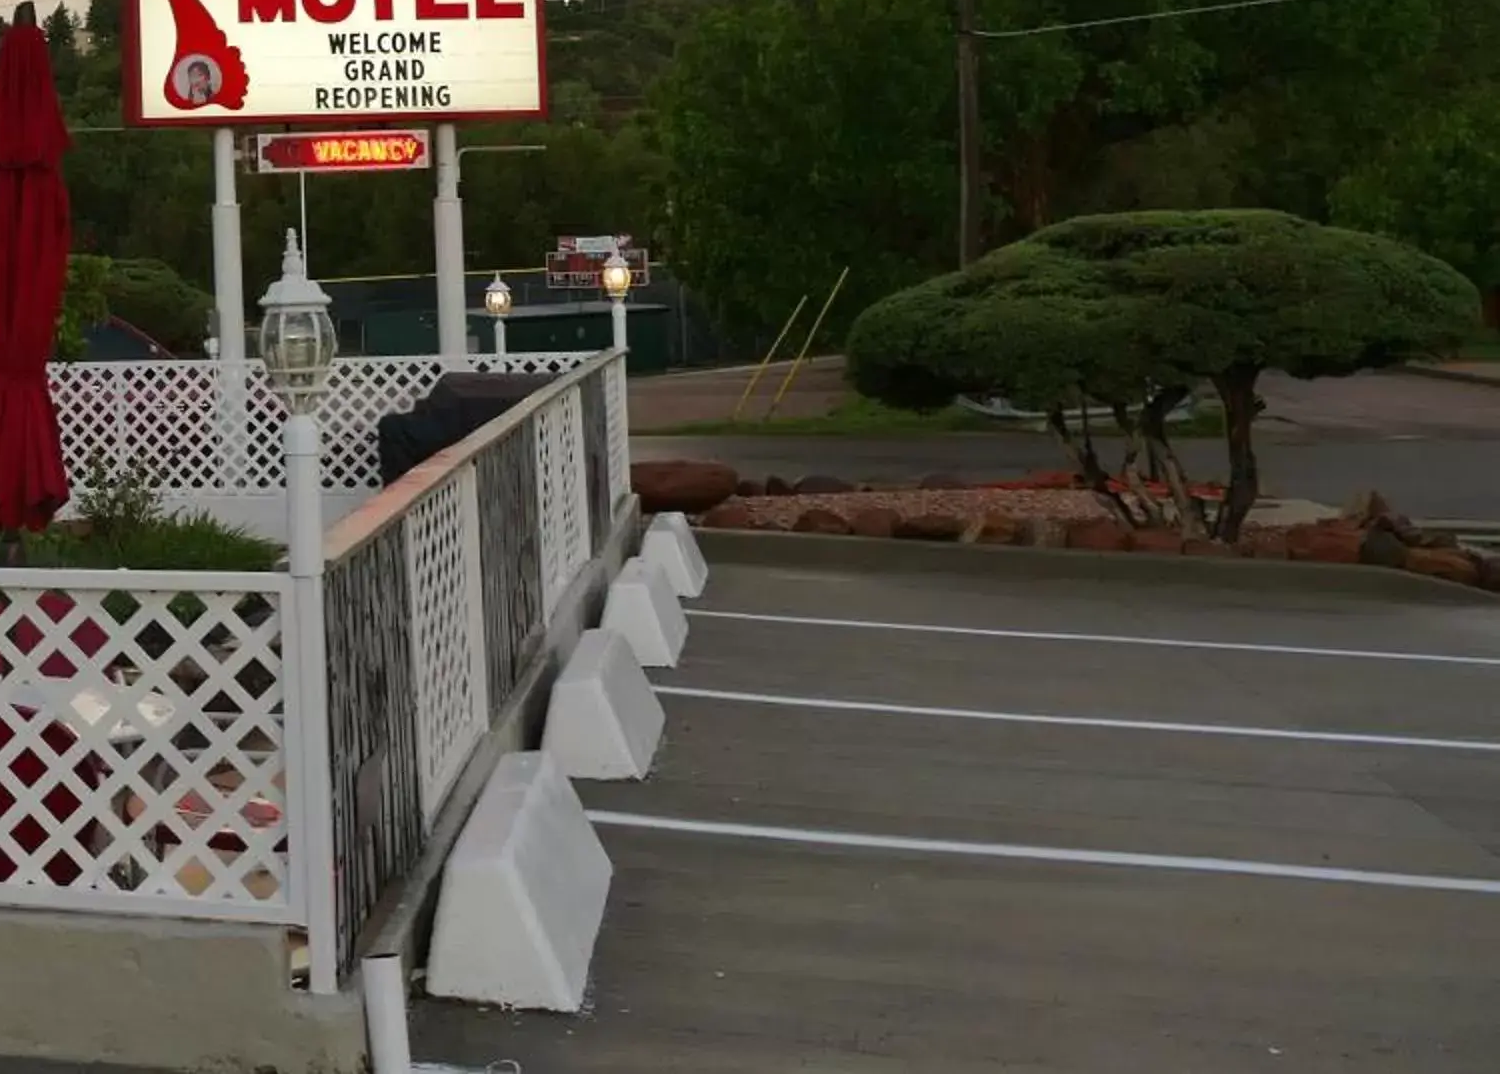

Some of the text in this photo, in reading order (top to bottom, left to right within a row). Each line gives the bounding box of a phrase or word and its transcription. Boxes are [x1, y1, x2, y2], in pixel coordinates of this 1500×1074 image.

[328, 32, 441, 55] WELCOME
[344, 59, 425, 81] GRAND
[315, 85, 451, 109] REOPENING
[312, 137, 418, 163] VACANCY
